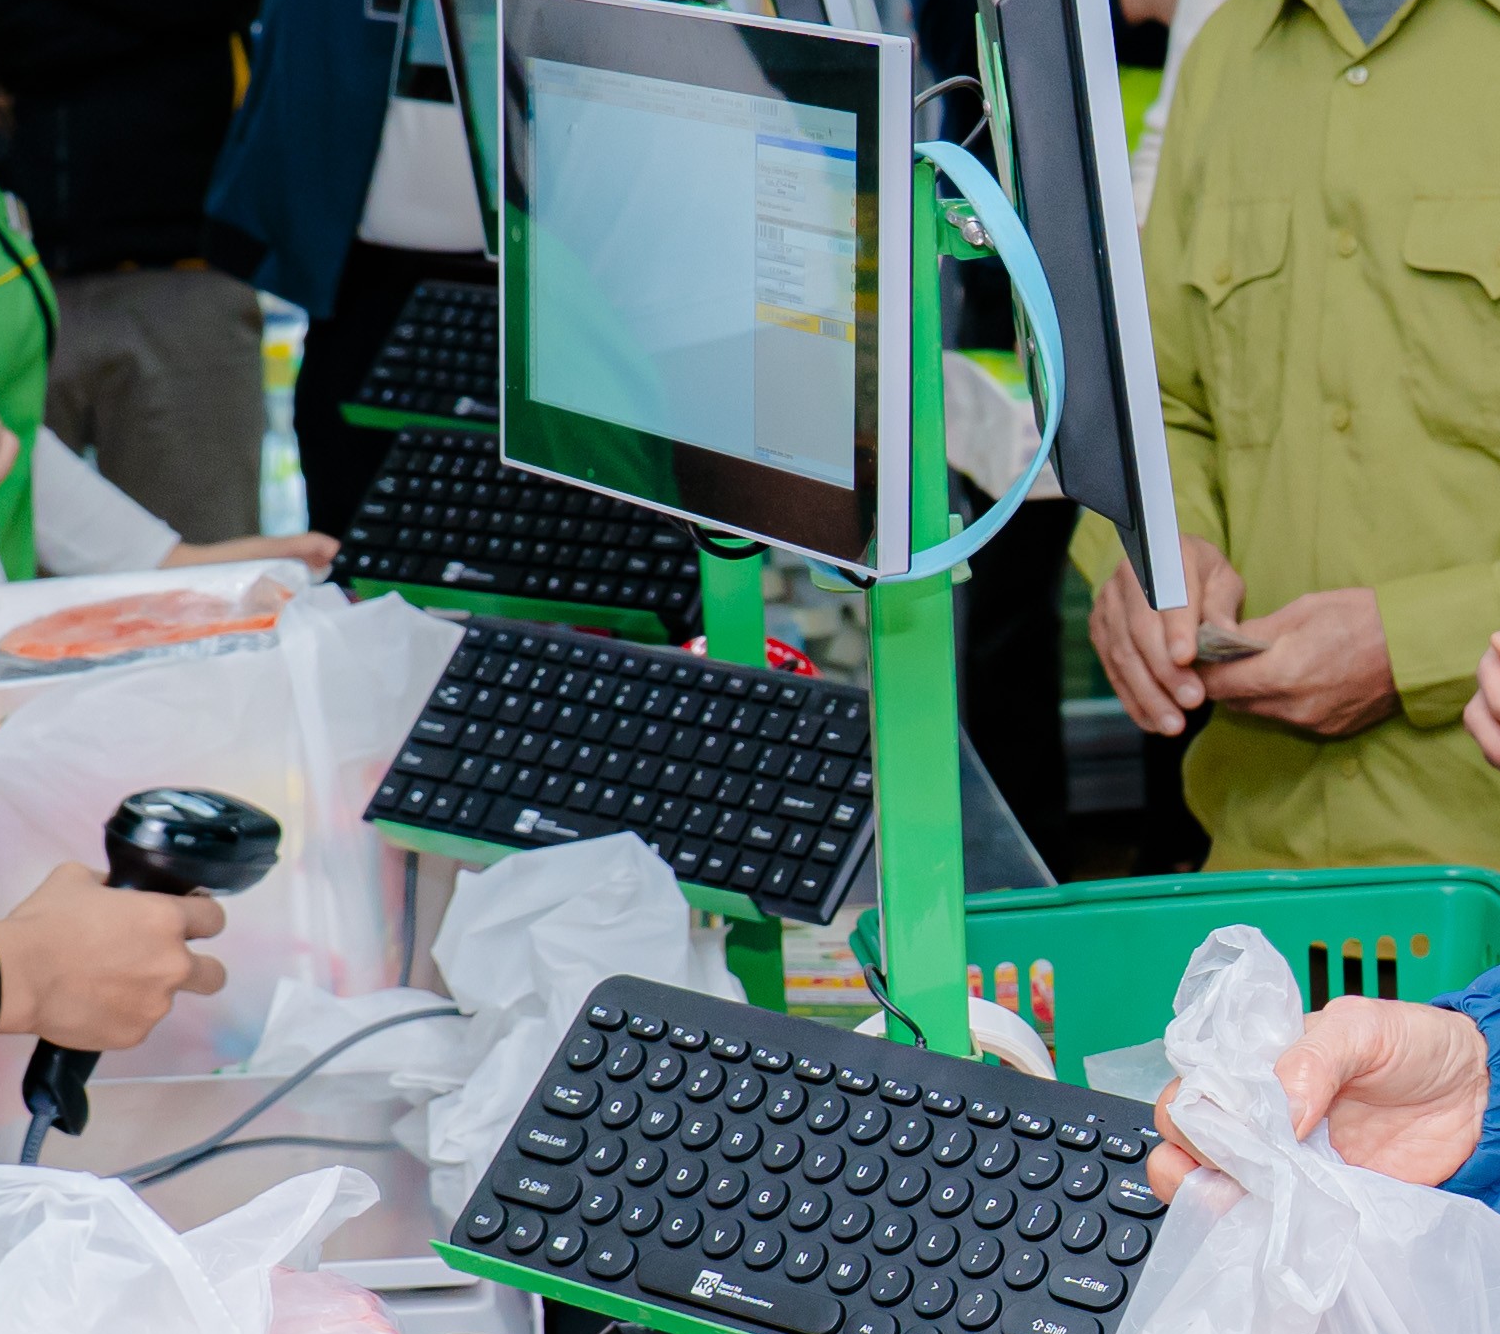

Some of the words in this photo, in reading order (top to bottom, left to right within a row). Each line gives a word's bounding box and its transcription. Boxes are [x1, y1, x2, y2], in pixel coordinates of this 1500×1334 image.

[610, 1102, 622, 1113] Q
[651, 1112, 664, 1124] W
[691, 1122, 702, 1134] E
[529, 1130, 551, 1144] Caps
[550, 1135, 567, 1147] Lock
[731, 1133, 743, 1145] R
[595, 1148, 605, 1158] A
[775, 1144, 784, 1155] T
[636, 1158, 646, 1169] S
[816, 1155, 826, 1167] Y
[677, 1169, 687, 1180] D
[857, 1166, 868, 1177] U
[529, 1180, 551, 1195] Shift
[718, 1180, 729, 1190] F
[759, 1191, 770, 1203] G
[943, 1188, 954, 1199] O
[590, 1196, 602, 1208] Z
[800, 1202, 812, 1213] H
[985, 1199, 996, 1210] P
[630, 1208, 642, 1219] X
[843, 1214, 853, 1224] J
[672, 1219, 683, 1230] C
[715, 1230, 725, 1241] V
[885, 1225, 897, 1237] K
[754, 1241, 765, 1252] B
[928, 1236, 935, 1247] L
[796, 1252, 808, 1264] N
[838, 1264, 851, 1276] M
[1081, 1278, 1109, 1292] Enter
